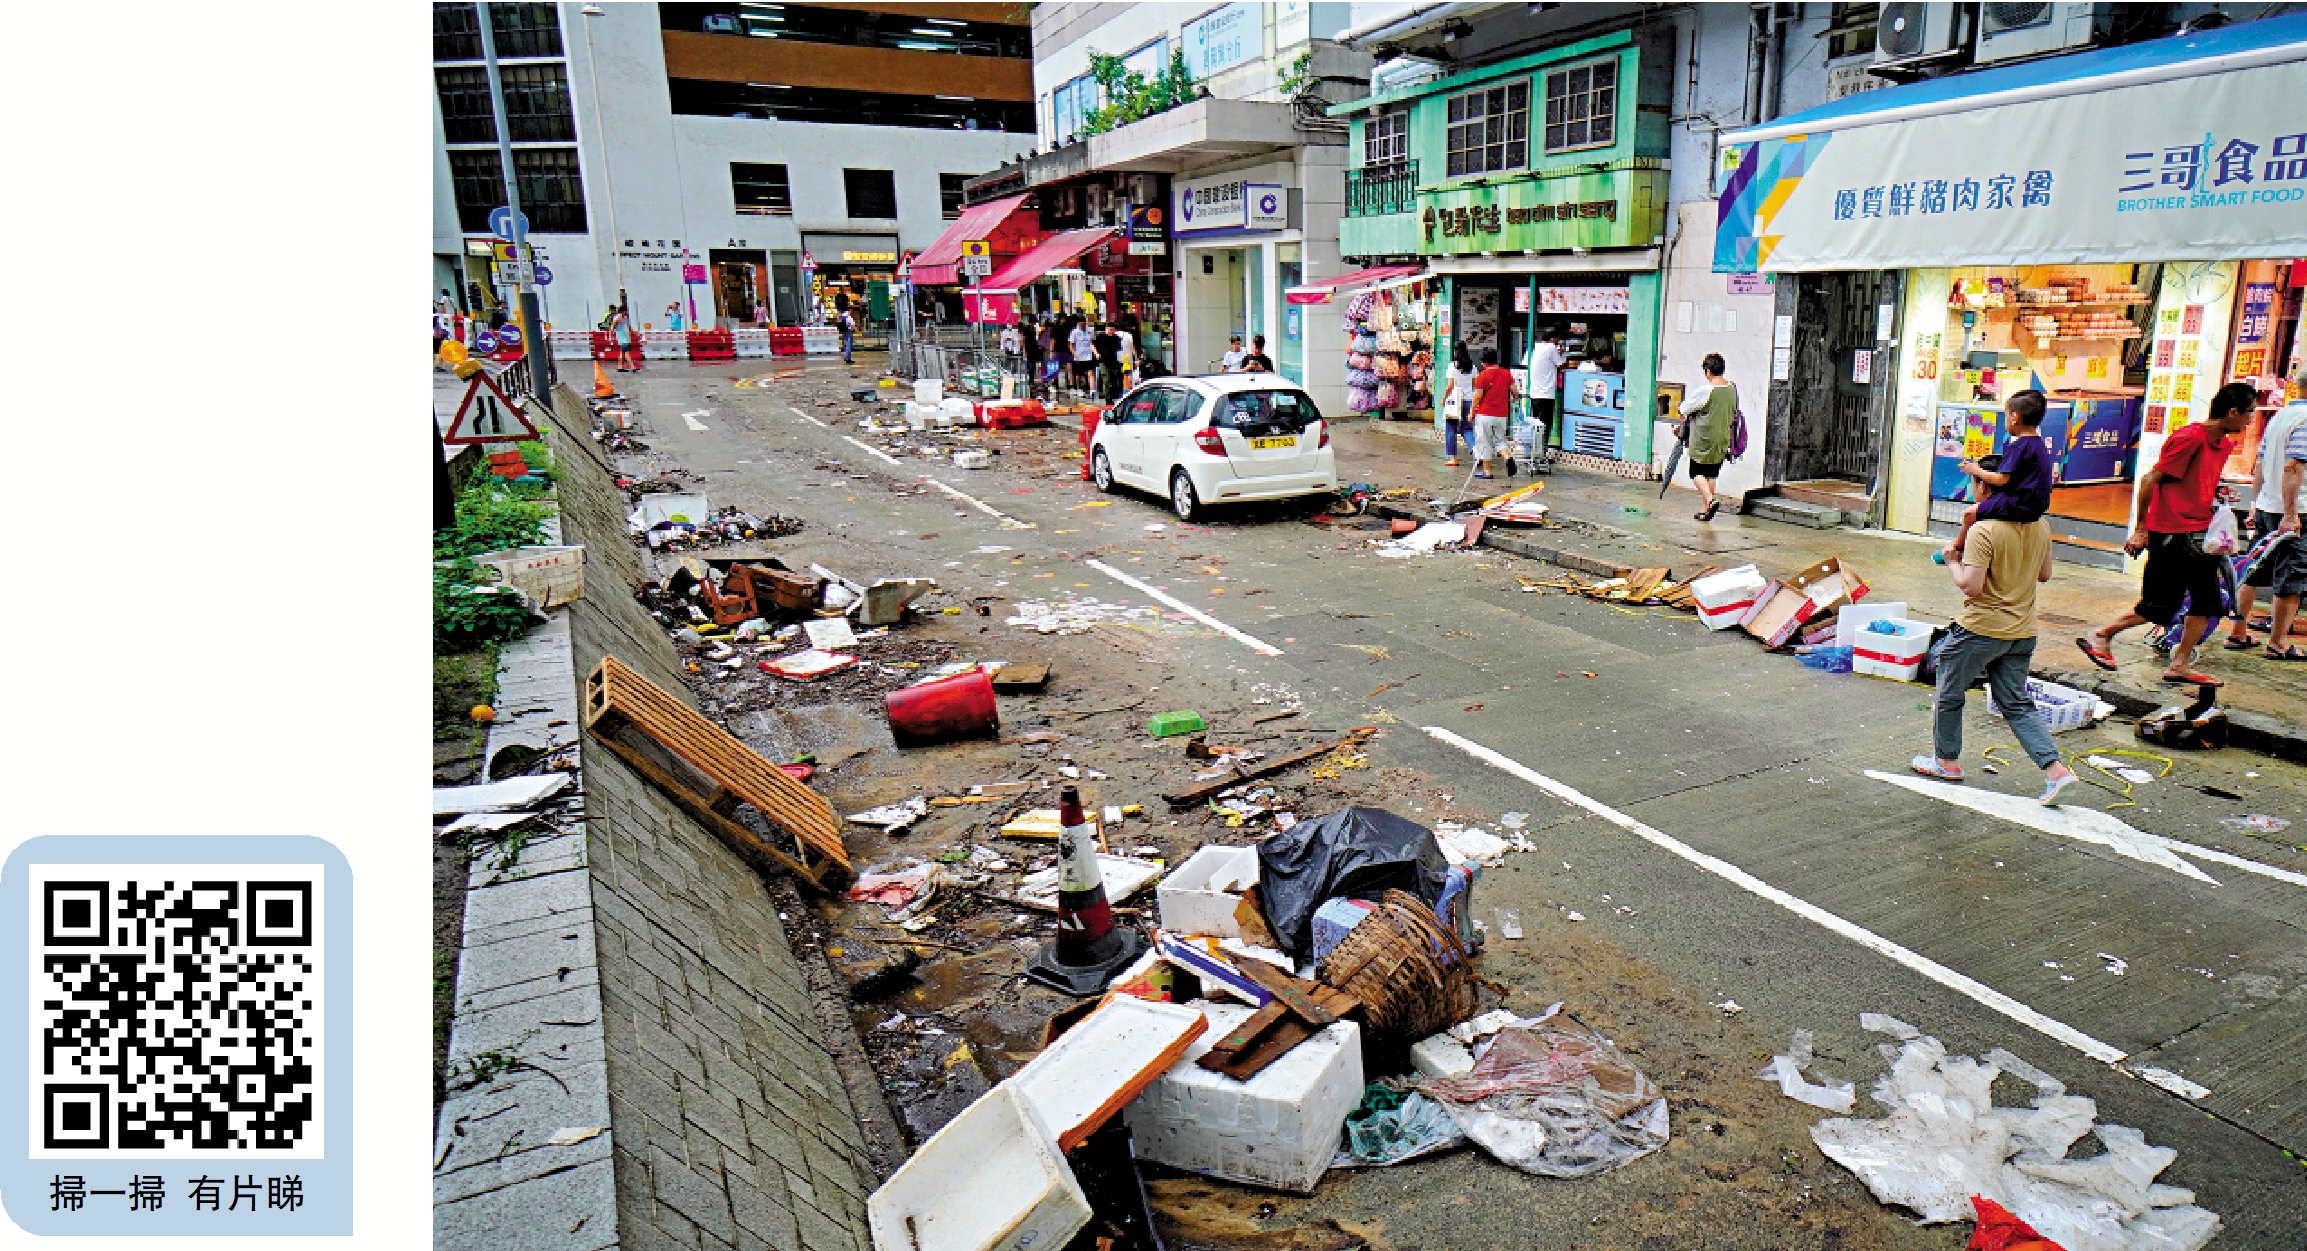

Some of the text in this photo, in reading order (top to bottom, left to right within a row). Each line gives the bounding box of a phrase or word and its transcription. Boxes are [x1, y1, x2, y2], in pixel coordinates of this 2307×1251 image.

[2118, 132, 2307, 193] 三哥食品
[1834, 169, 2055, 221] 優質鮮豬肉家禽
[2117, 187, 2305, 212] BROTHER SMART FOOD
